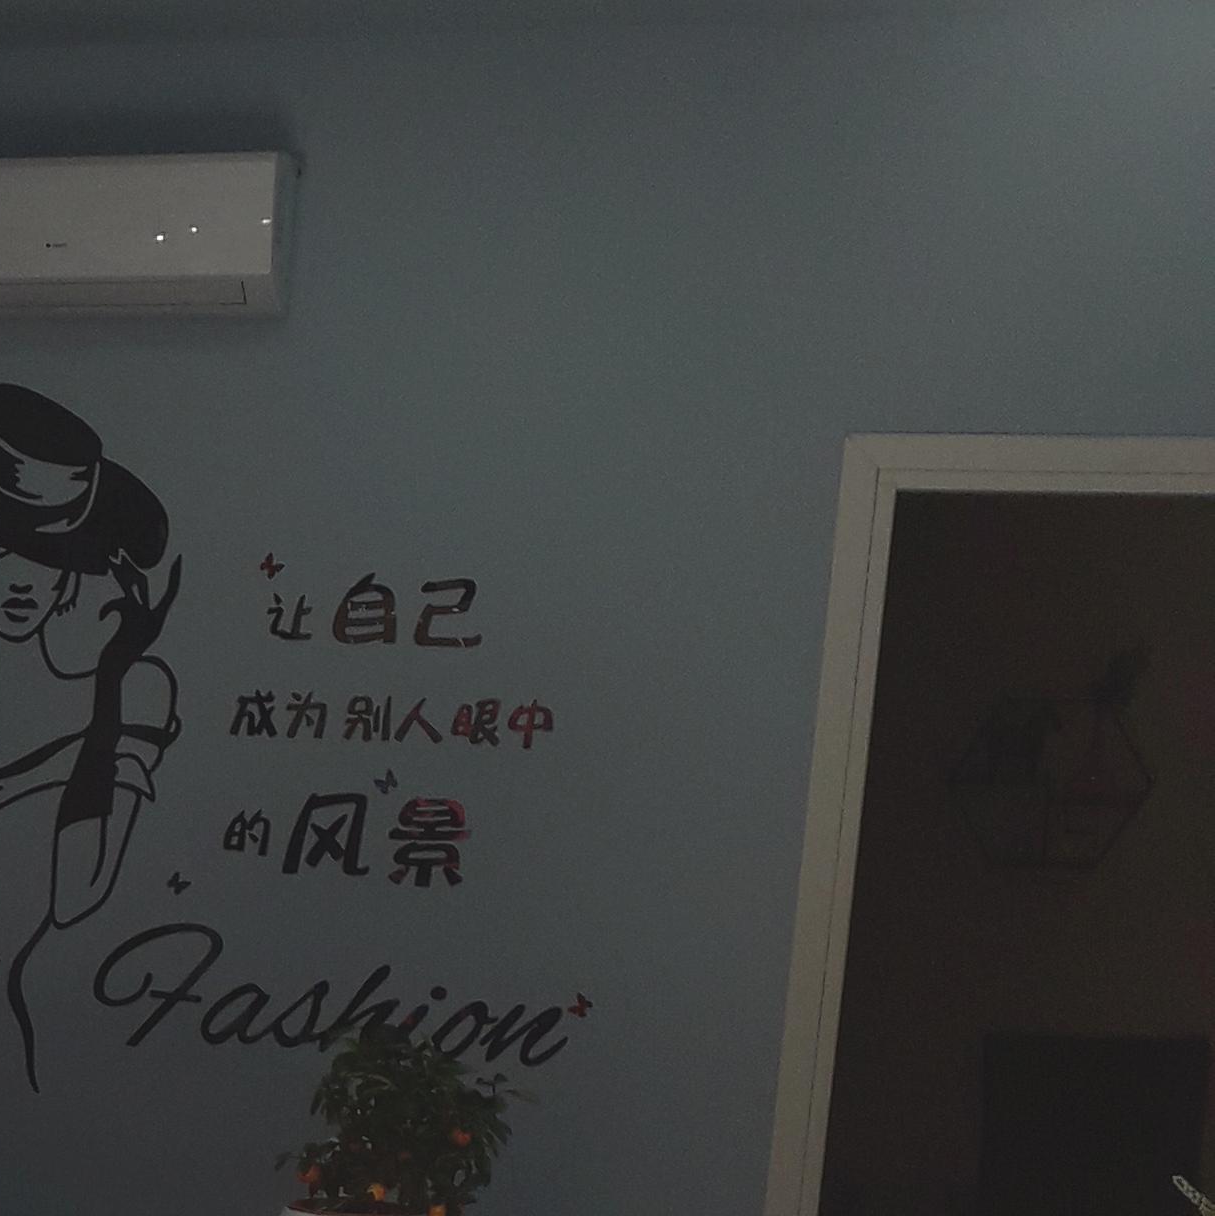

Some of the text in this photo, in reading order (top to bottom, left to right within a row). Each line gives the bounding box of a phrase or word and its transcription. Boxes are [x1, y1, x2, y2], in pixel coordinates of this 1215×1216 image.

[267, 573, 482, 648] 让自己
[230, 690, 554, 749] 成为别人眼中
[223, 793, 470, 887] 的风景
[93, 922, 569, 1066] Fashion
